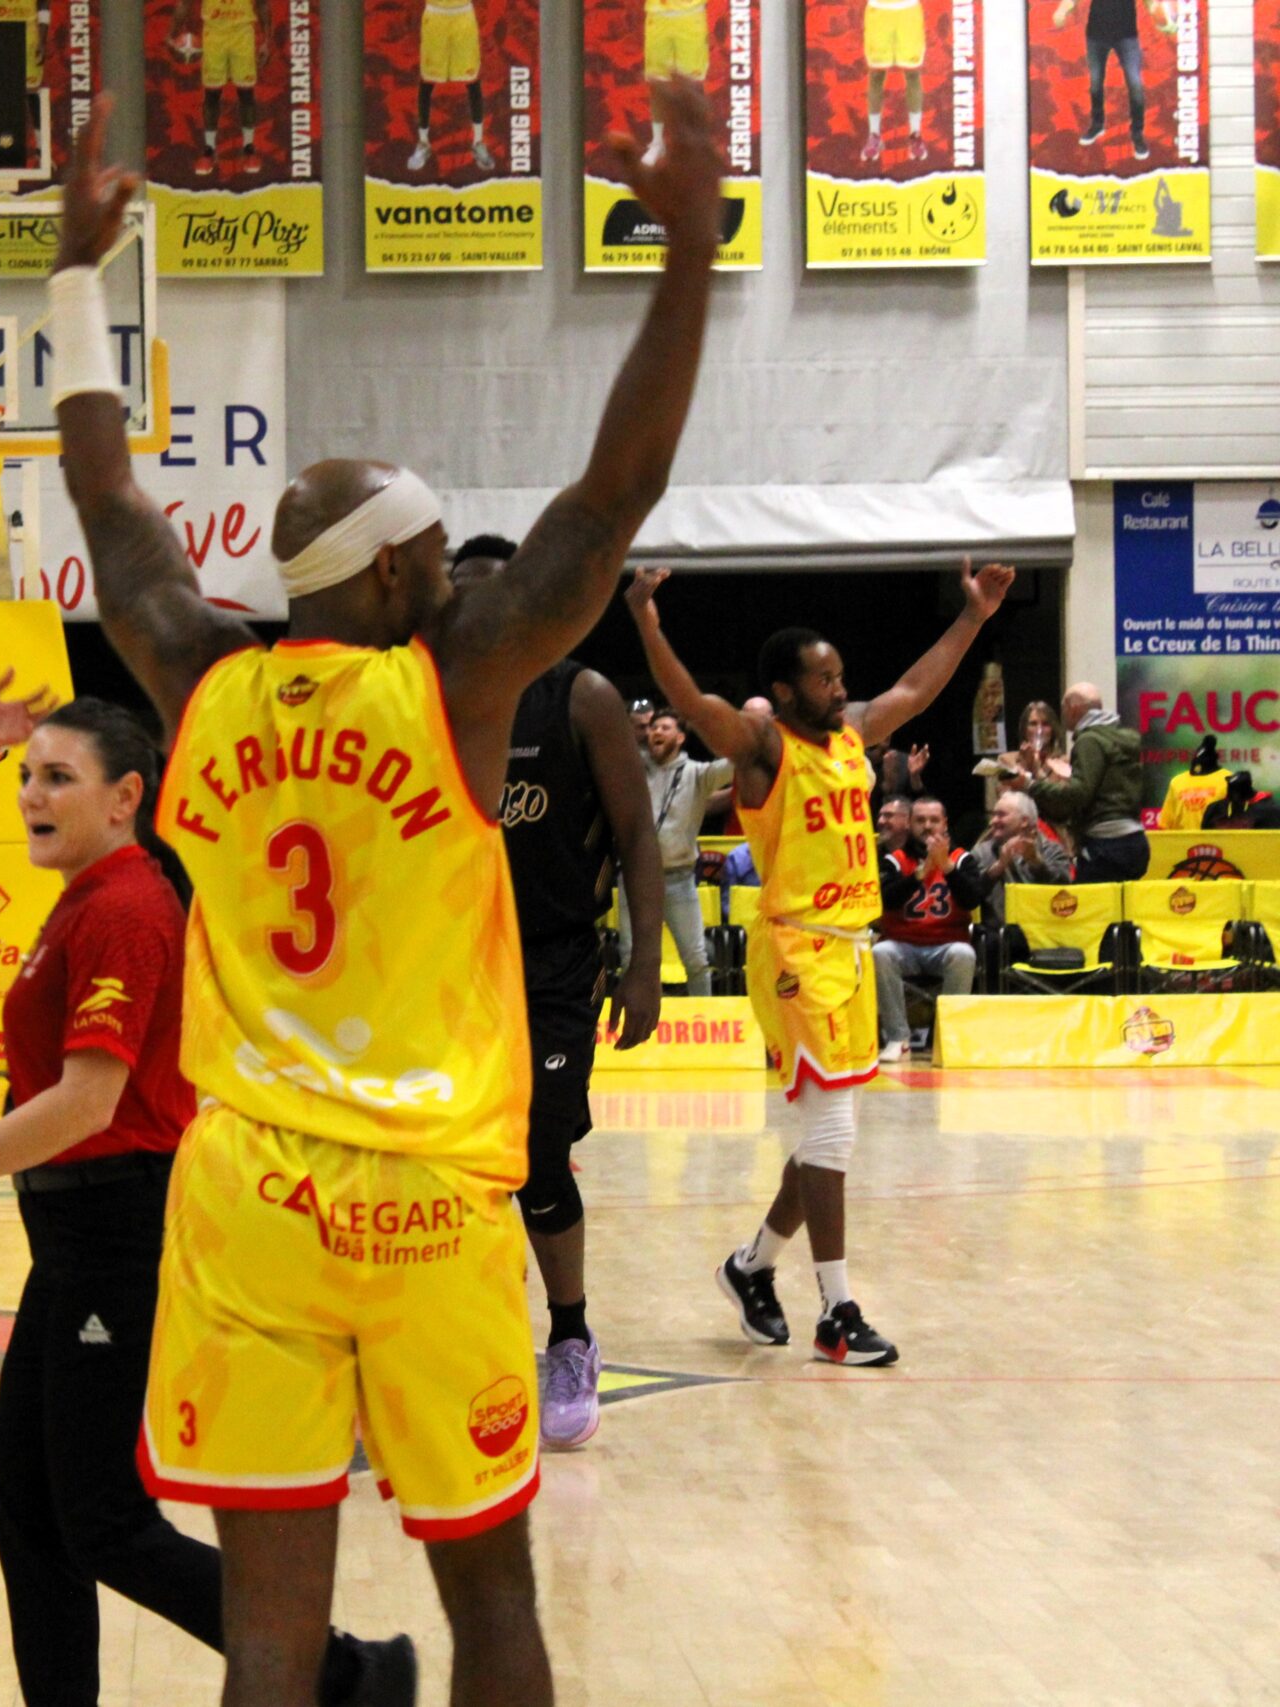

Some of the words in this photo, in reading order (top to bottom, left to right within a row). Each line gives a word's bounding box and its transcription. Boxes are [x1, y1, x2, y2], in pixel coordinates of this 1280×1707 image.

[70, 0, 91, 92] KALEMB
[510, 66, 530, 109] GEU
[727, 86, 751, 172] JÉRÔME
[952, 76, 975, 166] NATHAN
[1175, 76, 1198, 163] JÉRÔME
[290, 110, 311, 177] DAVID
[510, 115, 530, 171] DENG
[375, 201, 535, 226] vanatome
[817, 190, 898, 217] Versus
[177, 210, 240, 255] Tasty
[823, 219, 898, 236] éléments
[1141, 491, 1171, 508] Café
[1123, 514, 1189, 530] Restaurant
[1198, 542, 1224, 558] LA
[1123, 617, 1162, 631] Ouvert
[1165, 617, 1176, 630] le
[1178, 616, 1205, 630] midi
[1207, 616, 1222, 630] du
[1225, 615, 1254, 629] lundi
[1257, 619, 1271, 629] au
[1206, 593, 1268, 613] Cuisine
[1124, 636, 1143, 653] Le
[1147, 636, 1196, 652] Creux
[1200, 634, 1222, 652] de
[1226, 634, 1242, 651] la
[1138, 690, 1280, 734] FAUC
[804, 787, 870, 833] SVB
[267, 817, 337, 975] 3
[904, 882, 952, 919] 23
[657, 1013, 746, 1045] DRÔME
[258, 1172, 465, 1251] CALEGARI
[178, 1401, 197, 1448] 3
[474, 1392, 523, 1420] SPORT
